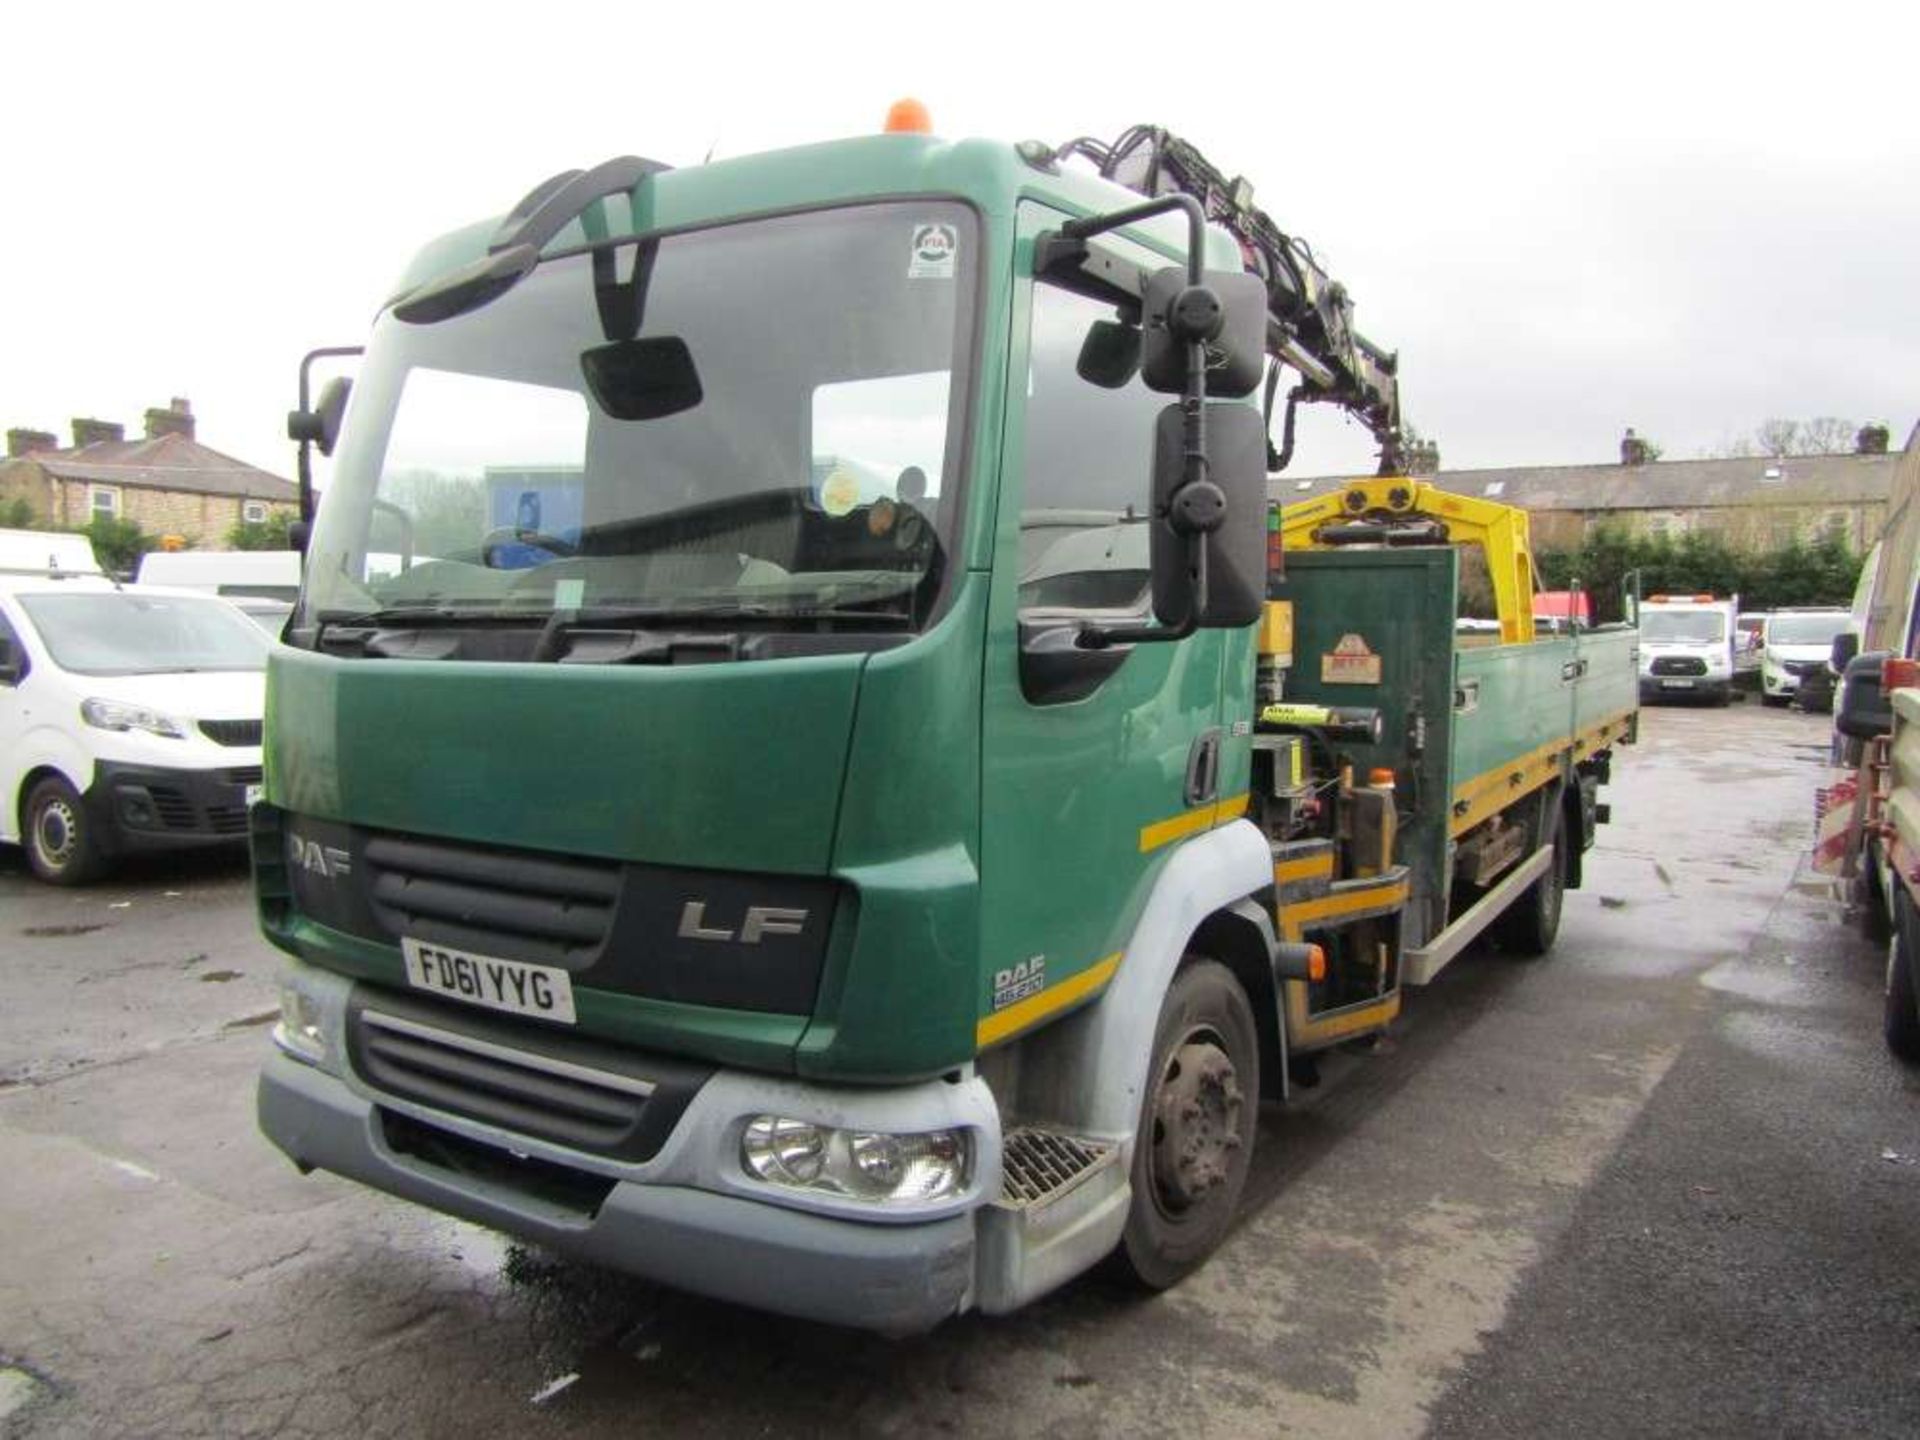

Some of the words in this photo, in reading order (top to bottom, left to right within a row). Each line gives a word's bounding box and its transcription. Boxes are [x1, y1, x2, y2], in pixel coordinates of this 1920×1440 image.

[288, 832, 351, 877] DAF
[677, 901, 808, 943] LF
[995, 954, 1045, 988] DAF
